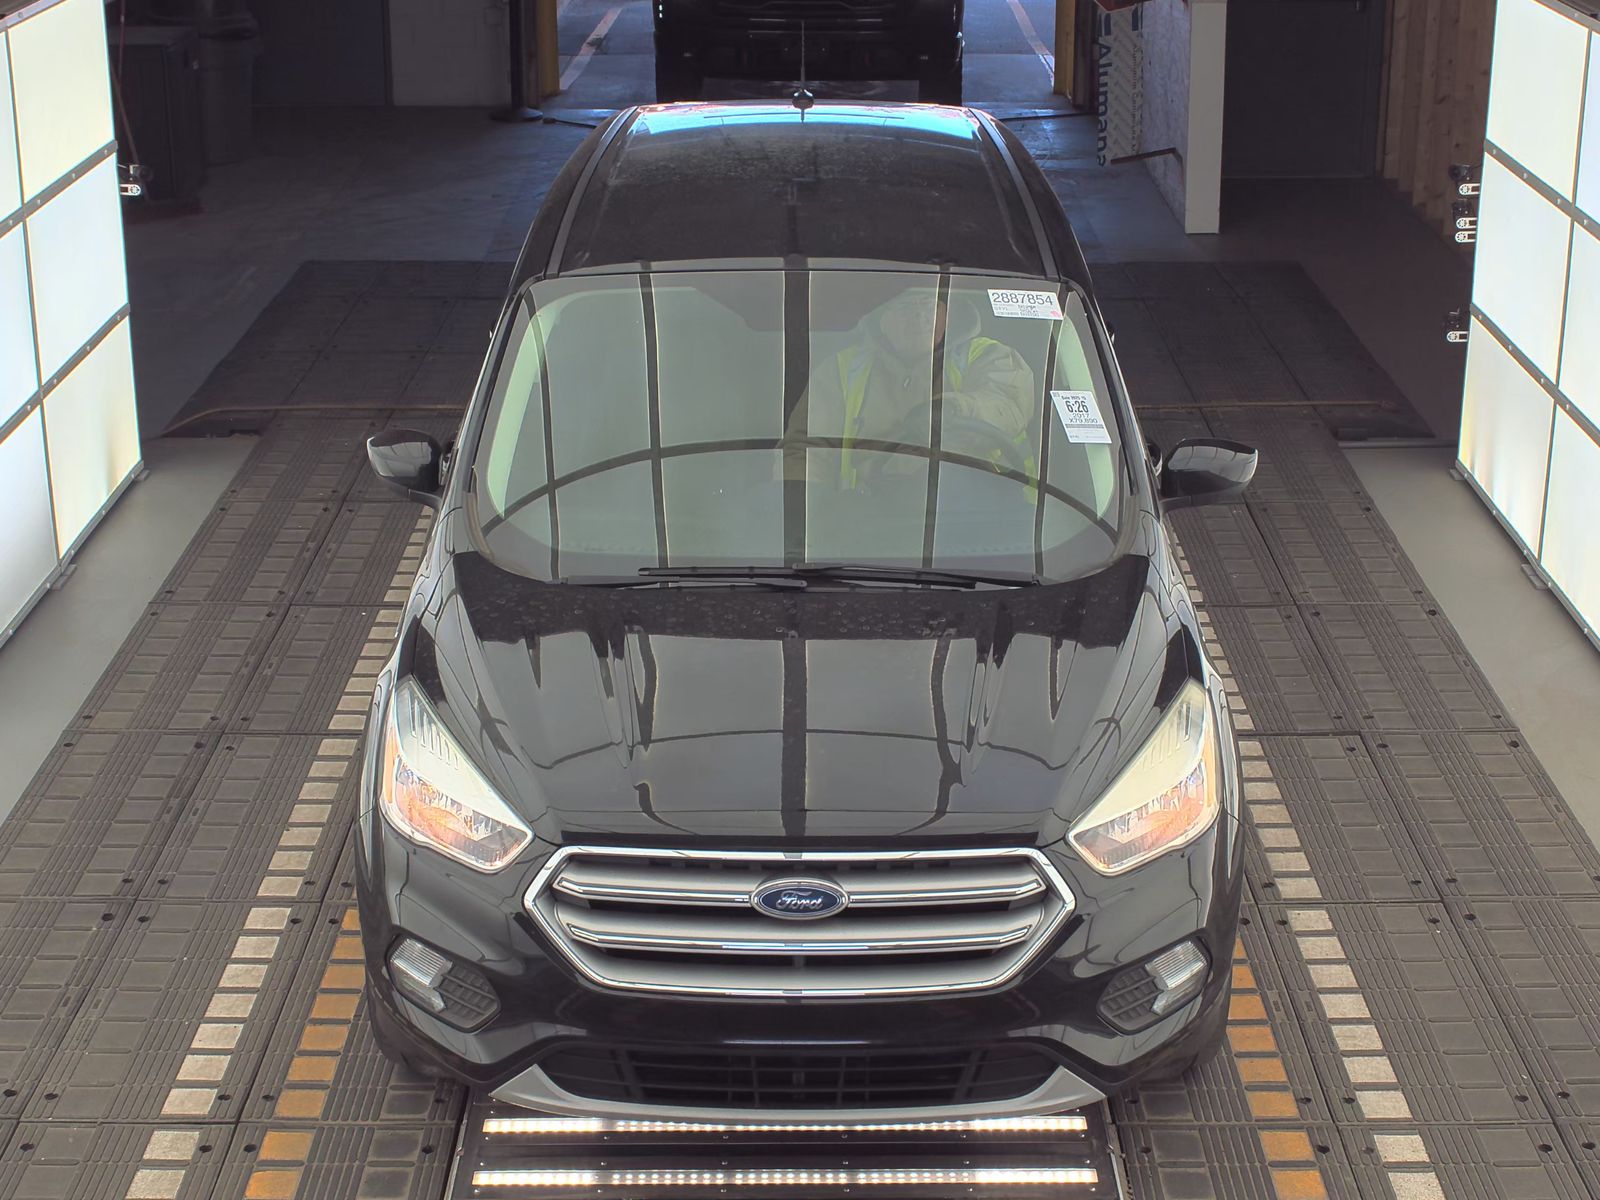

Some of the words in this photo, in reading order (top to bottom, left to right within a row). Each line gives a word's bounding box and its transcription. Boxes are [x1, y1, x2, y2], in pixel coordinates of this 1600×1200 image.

[991, 292, 1053, 306] 2887854
[1065, 400, 1089, 413] 6:26
[775, 890, 824, 910] Ford
